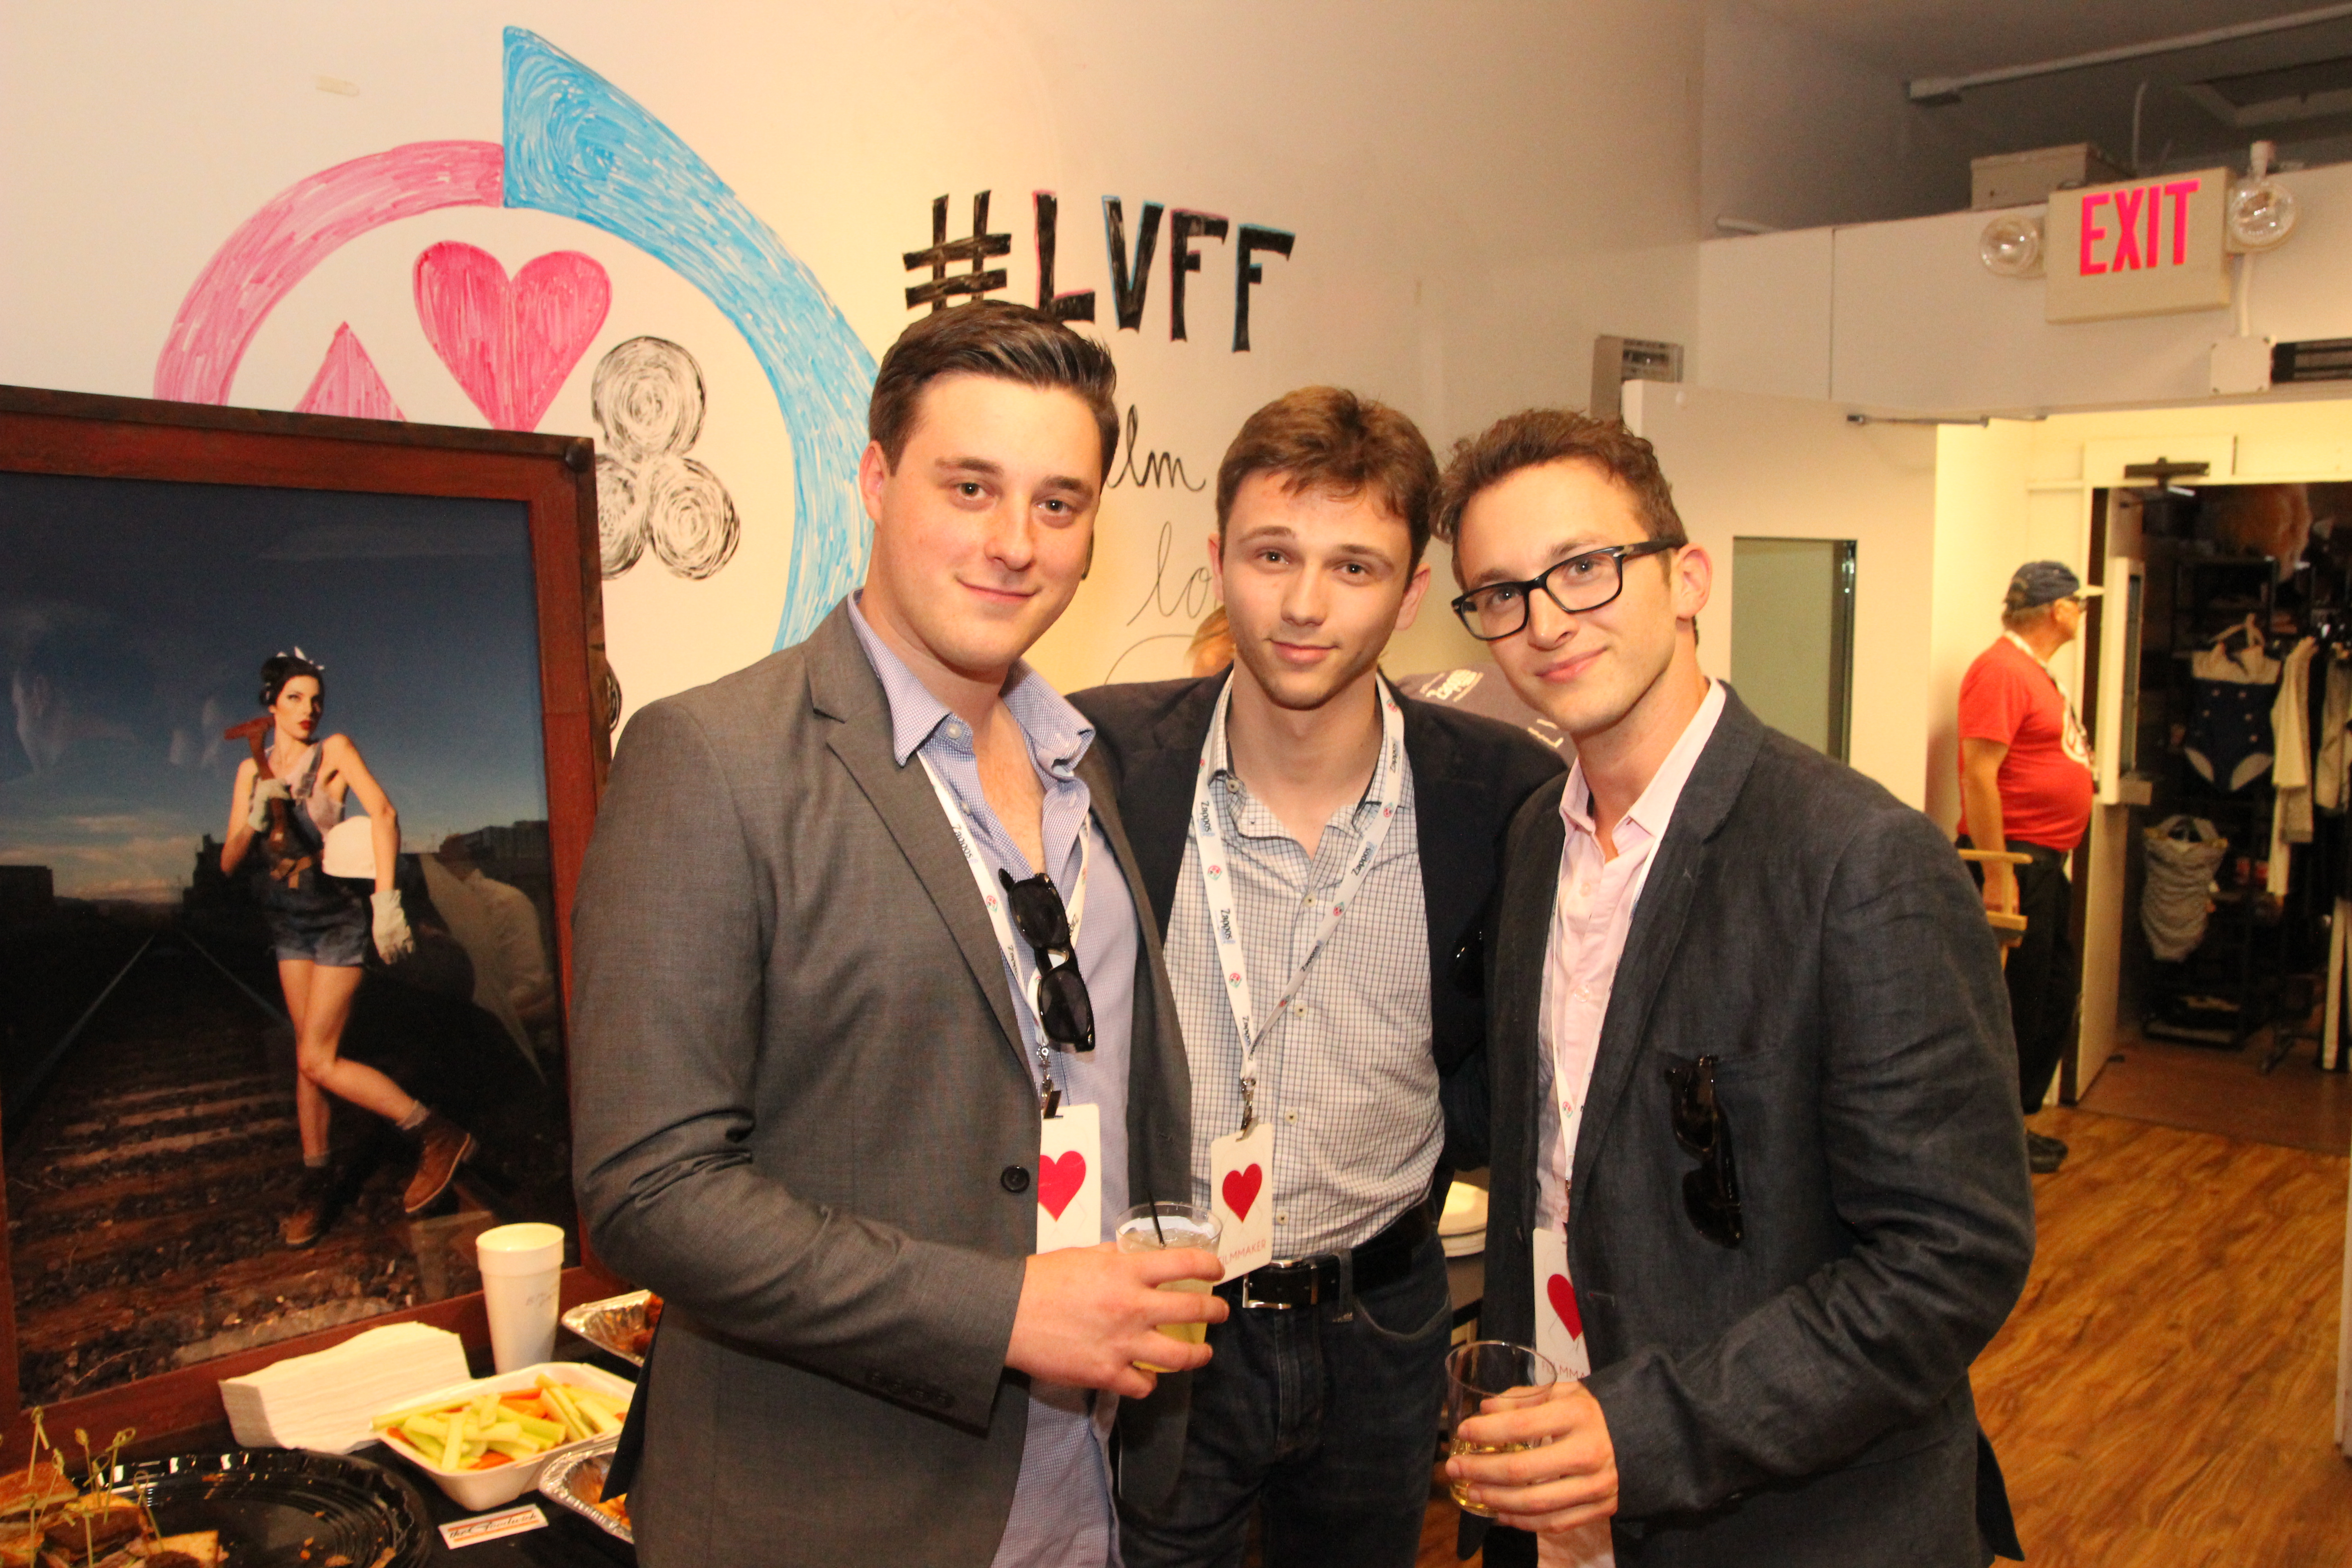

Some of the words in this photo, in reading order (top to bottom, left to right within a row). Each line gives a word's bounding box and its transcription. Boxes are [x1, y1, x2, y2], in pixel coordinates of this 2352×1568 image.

[2080, 178, 2201, 276] EXIT
[1200, 800, 1212, 832] Zappos
[952, 823, 973, 858] Zappos
[1351, 847, 1371, 877] Zappos
[1220, 908, 1233, 940] Zappos
[1300, 945, 1320, 972] Zappos
